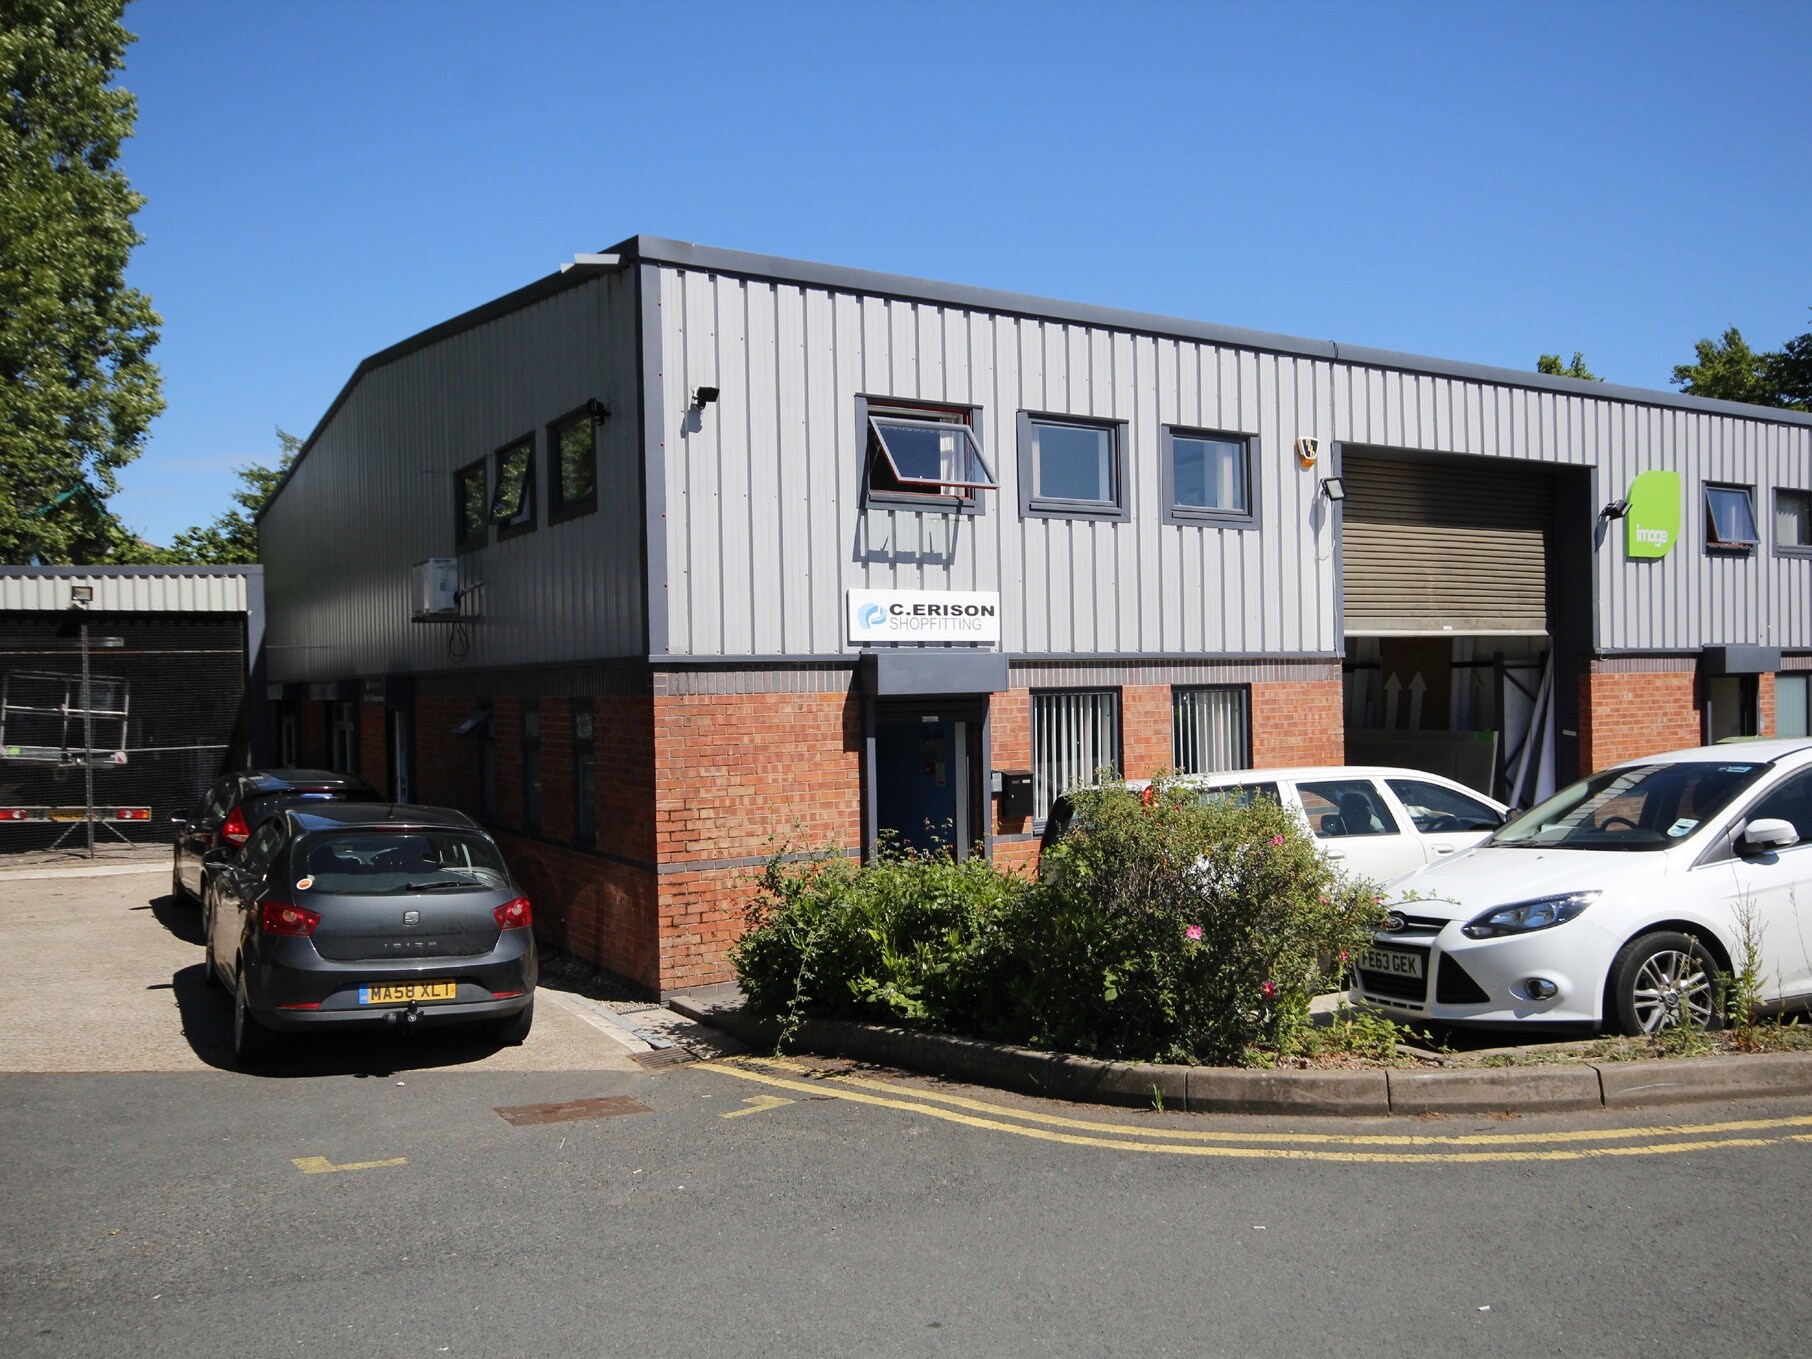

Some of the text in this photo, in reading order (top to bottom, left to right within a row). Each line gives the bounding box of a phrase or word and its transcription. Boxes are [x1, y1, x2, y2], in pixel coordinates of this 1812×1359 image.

[1636, 523, 1668, 548] image
[889, 603, 995, 617] C.ERISON
[889, 617, 982, 631] SHOPFITTING
[1392, 954, 1417, 975] GEK
[371, 982, 451, 1000] MA58 XLT
